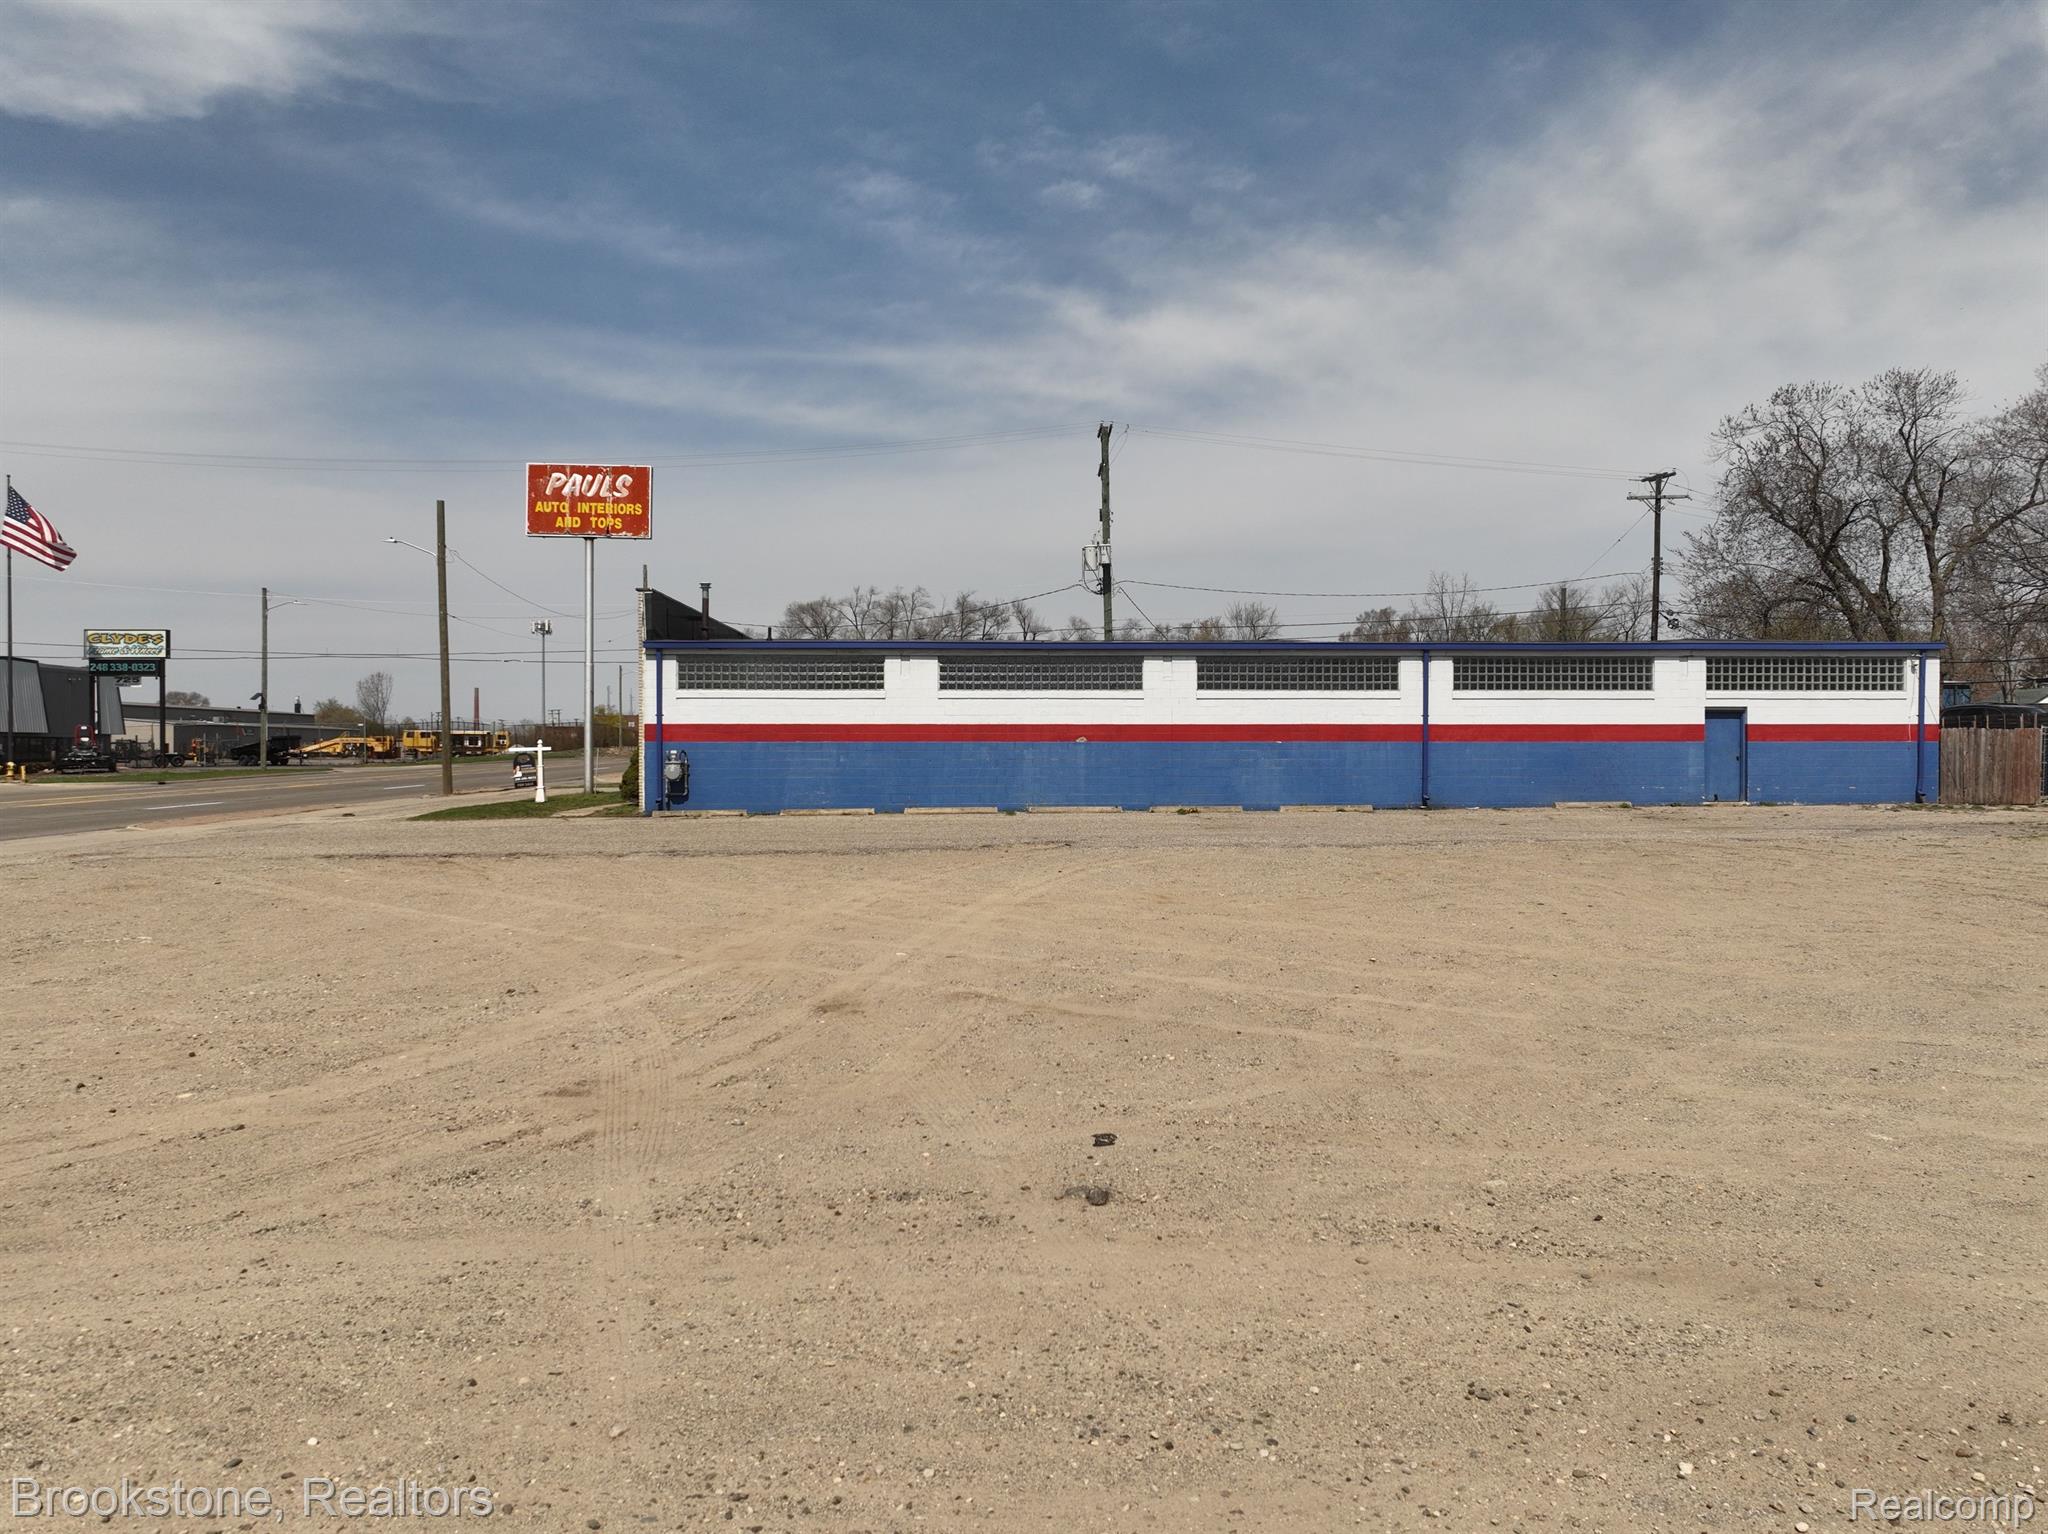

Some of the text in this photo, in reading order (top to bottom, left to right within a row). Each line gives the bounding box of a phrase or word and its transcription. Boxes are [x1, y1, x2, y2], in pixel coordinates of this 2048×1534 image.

[545, 472, 633, 497] PAULS
[535, 502, 643, 515] AUTO INTERIORS
[555, 517, 622, 529] AND TOPS
[87, 633, 164, 645] CLYDE'S
